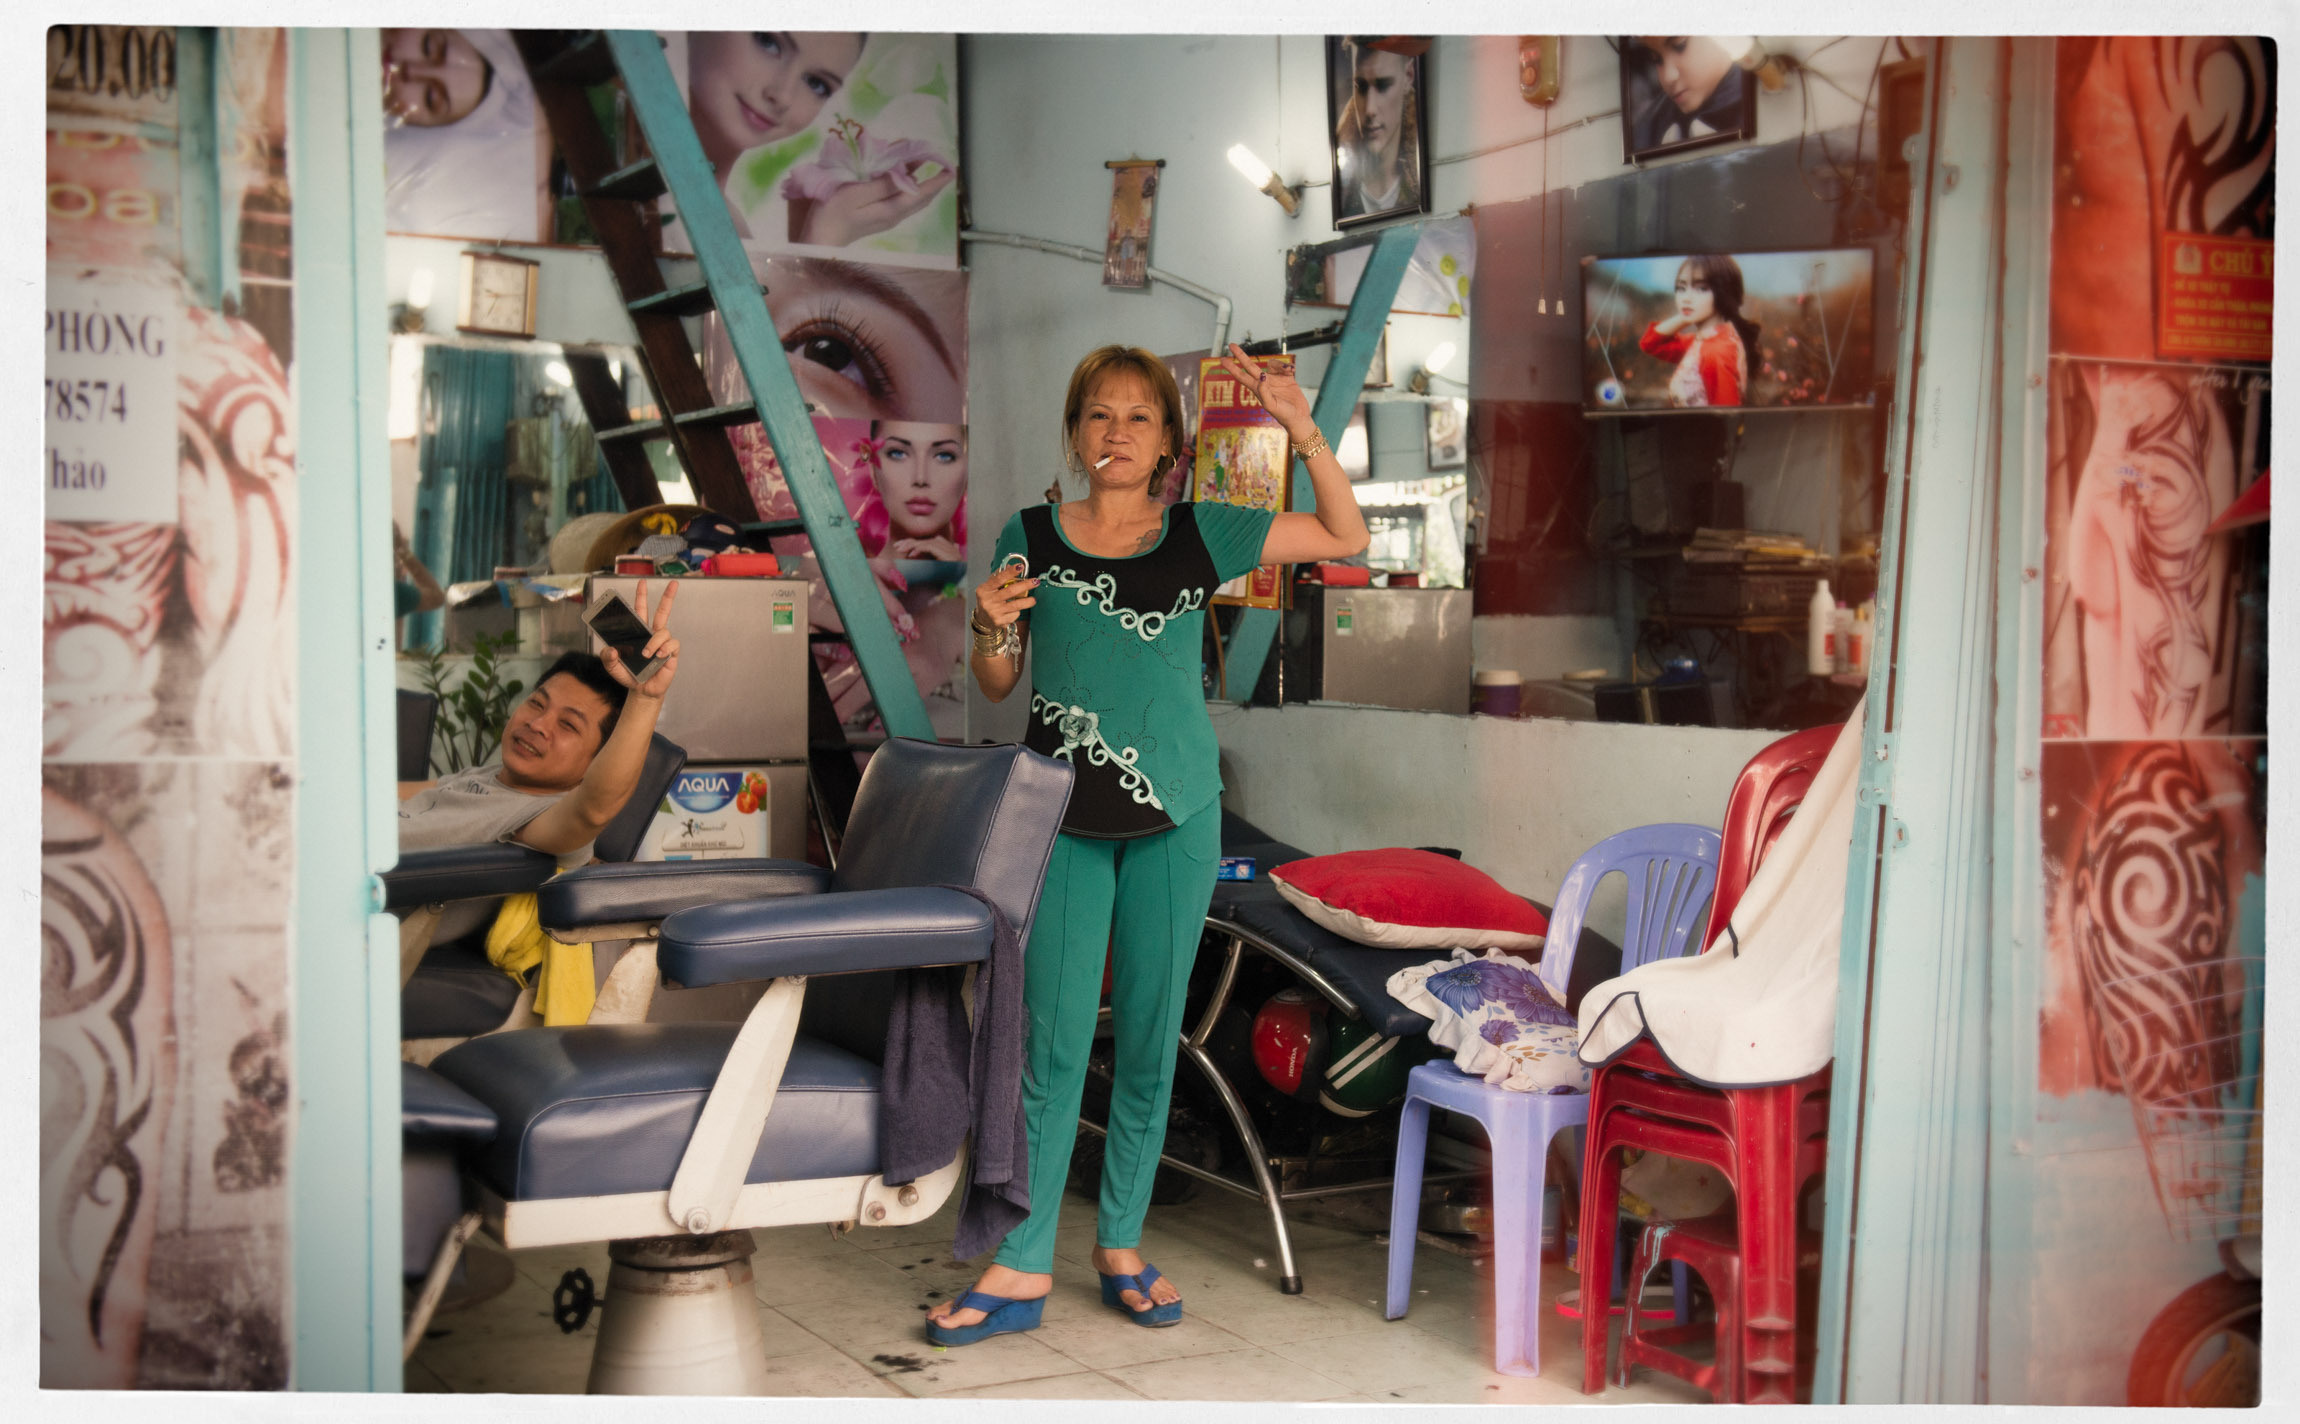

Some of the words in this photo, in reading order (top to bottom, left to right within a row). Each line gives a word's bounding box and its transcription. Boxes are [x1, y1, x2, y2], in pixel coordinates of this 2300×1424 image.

[2209, 247, 2255, 274] CHÚ
[771, 589, 797, 598] AQUA
[678, 777, 730, 793] AQUA
[1288, 1047, 1298, 1078] HONDA
